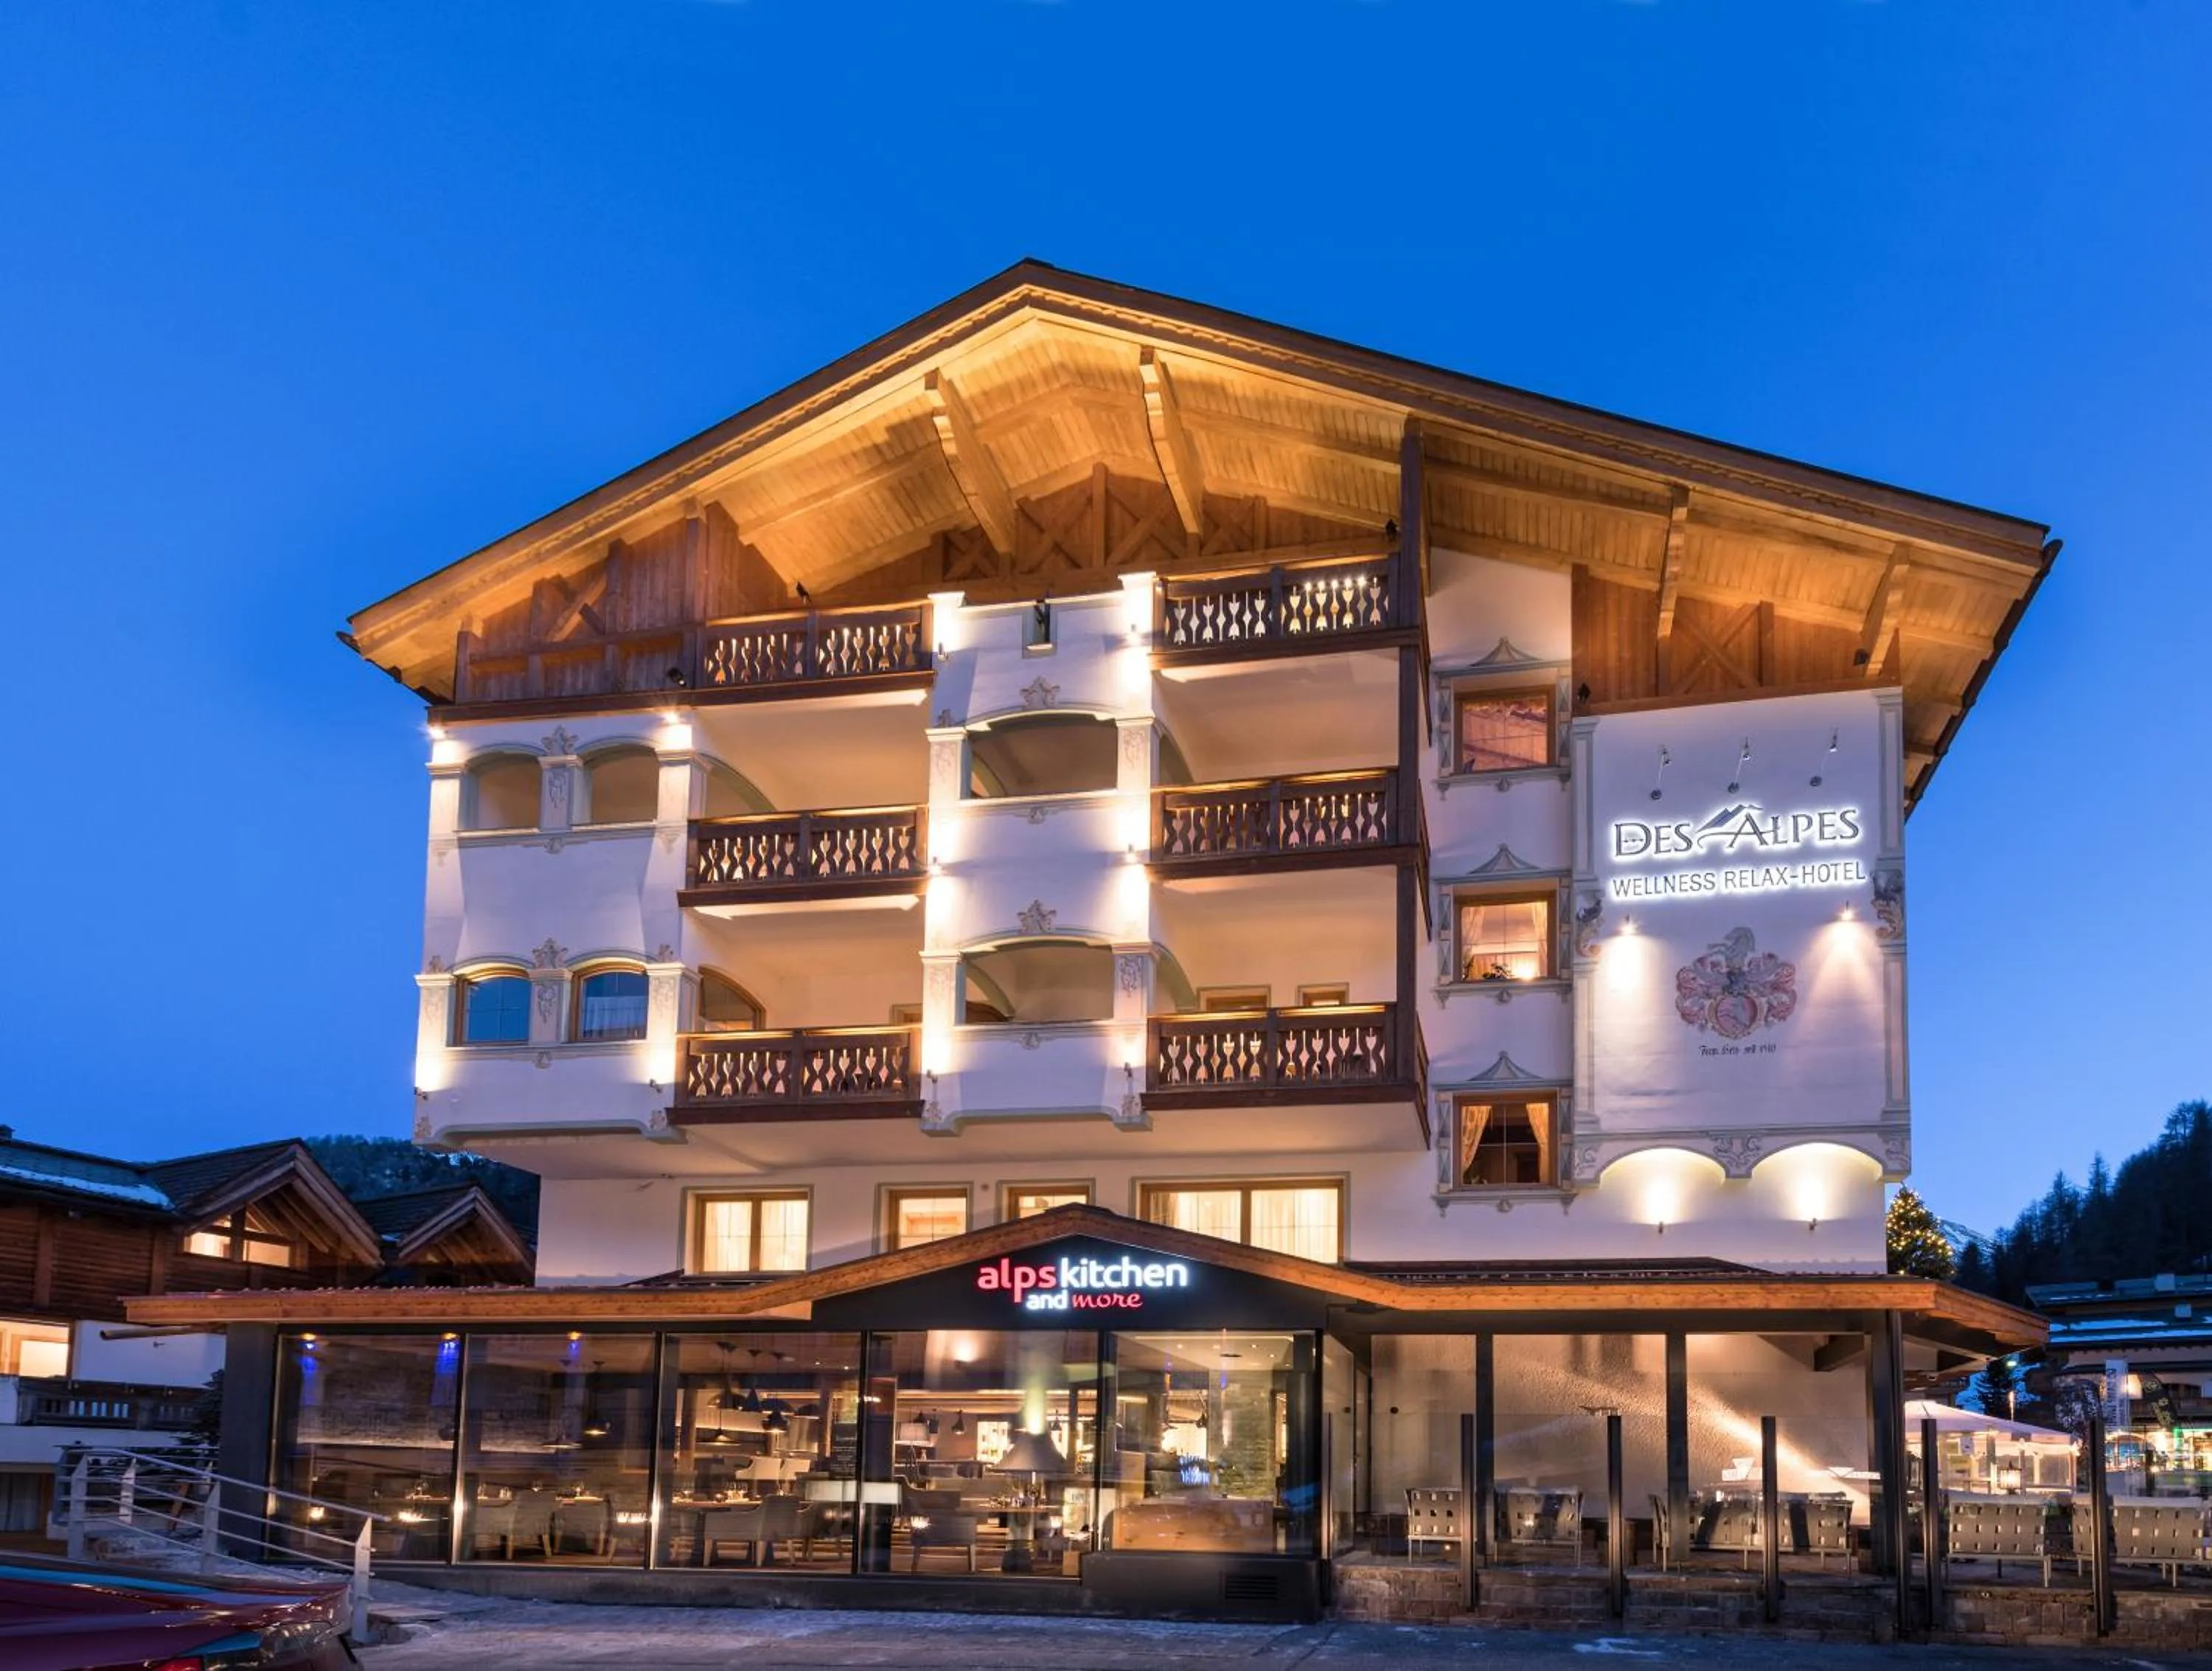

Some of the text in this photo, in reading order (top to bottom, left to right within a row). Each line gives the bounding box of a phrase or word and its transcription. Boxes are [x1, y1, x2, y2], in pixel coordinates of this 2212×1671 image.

[1614, 809, 1860, 857] DES ALPES
[1613, 861, 1866, 897] WELLNESS RELAX-HOTEL
[1026, 1290, 1143, 1310] and more
